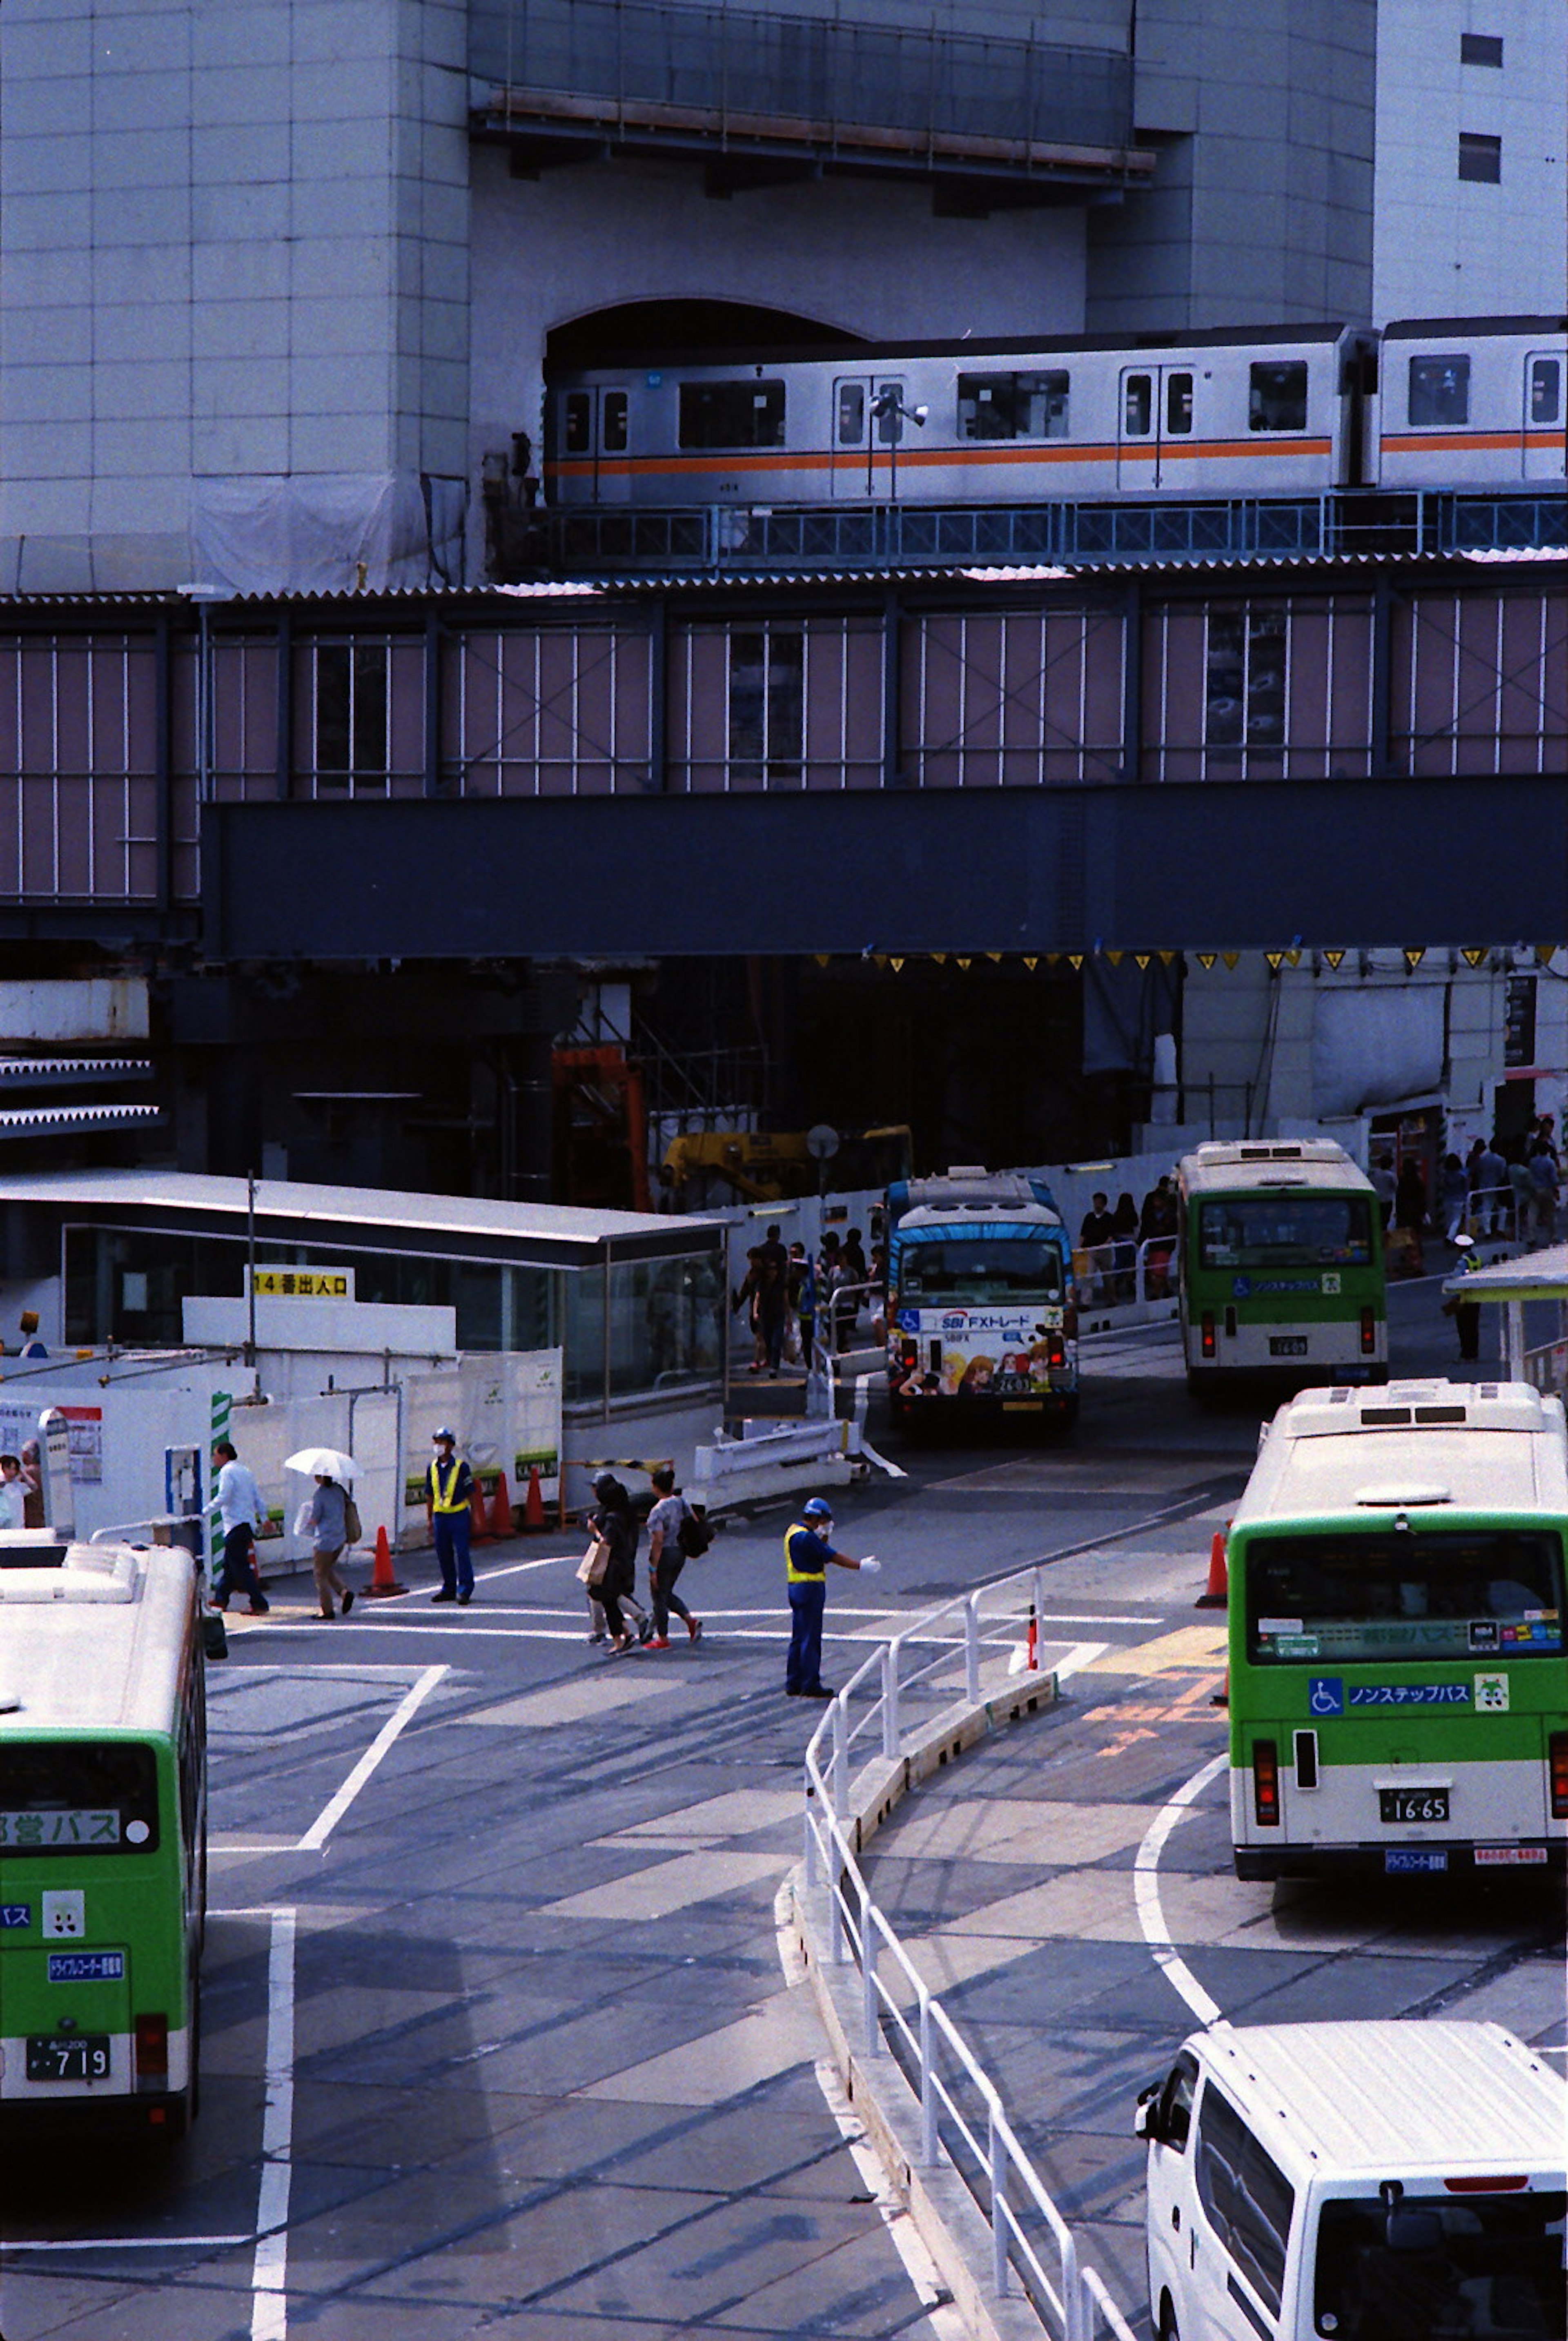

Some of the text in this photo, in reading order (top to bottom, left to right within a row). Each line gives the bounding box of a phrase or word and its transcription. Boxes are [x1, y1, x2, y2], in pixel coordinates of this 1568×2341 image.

[942, 1318, 963, 1328] SBI
[1351, 1686, 1469, 1703] ノンステップバス
